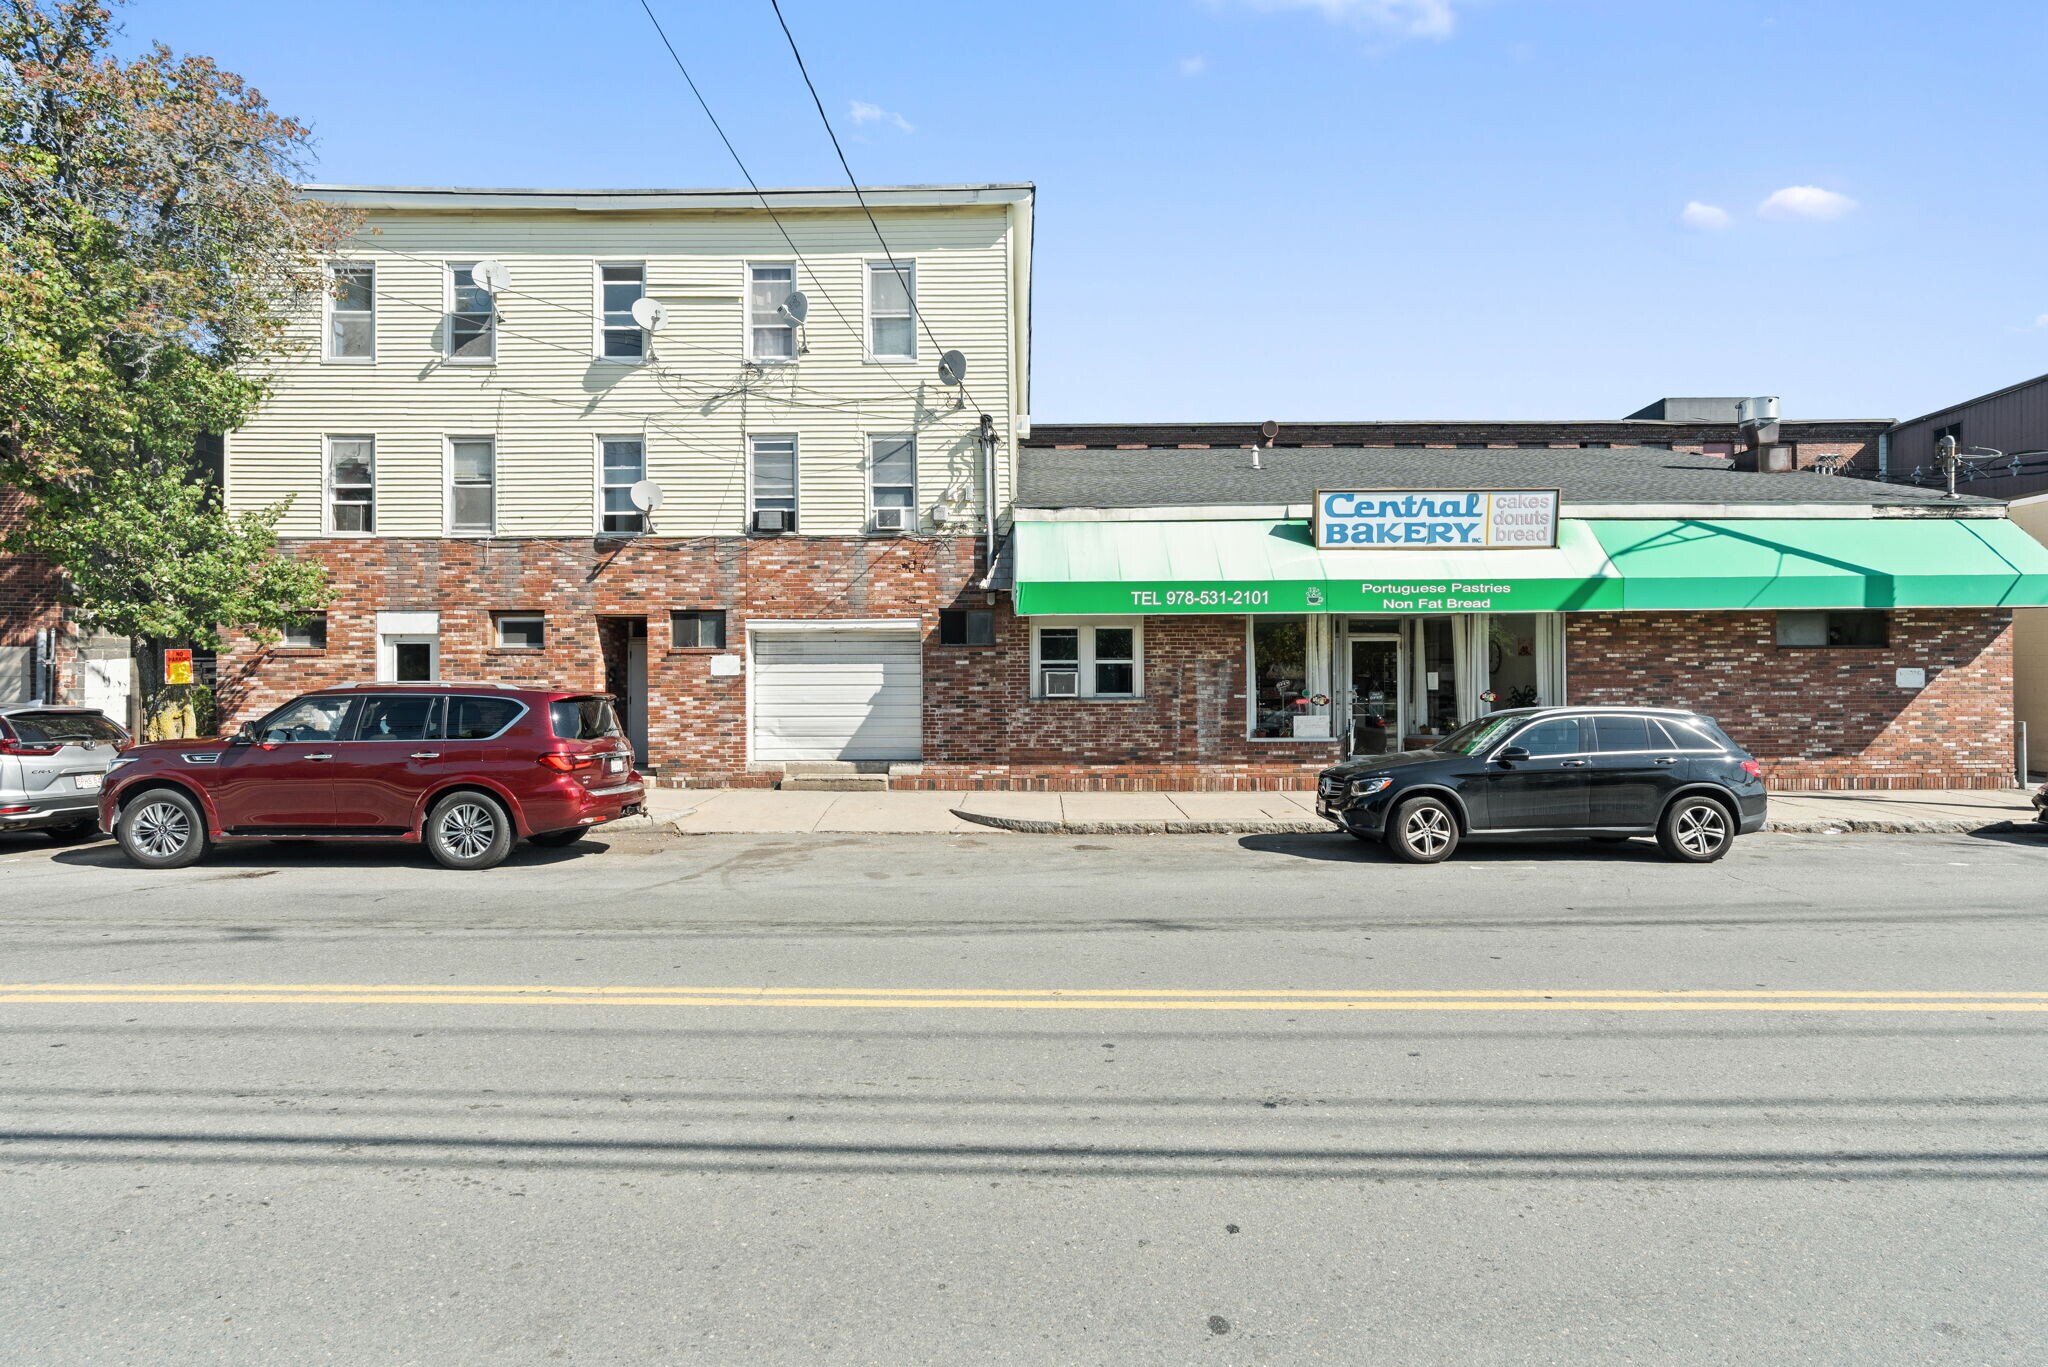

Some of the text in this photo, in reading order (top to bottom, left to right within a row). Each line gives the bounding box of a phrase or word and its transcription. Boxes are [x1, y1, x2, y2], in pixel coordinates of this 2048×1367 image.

[1324, 493, 1483, 518] Central
[1496, 493, 1550, 509] cakes
[1493, 510, 1550, 526] donuts
[1495, 526, 1548, 542] bread
[1361, 582, 1512, 596] Portuguese Pastries
[1131, 590, 1269, 606] TEL 978-531-2101
[1383, 598, 1491, 609] Non Fat Bread
